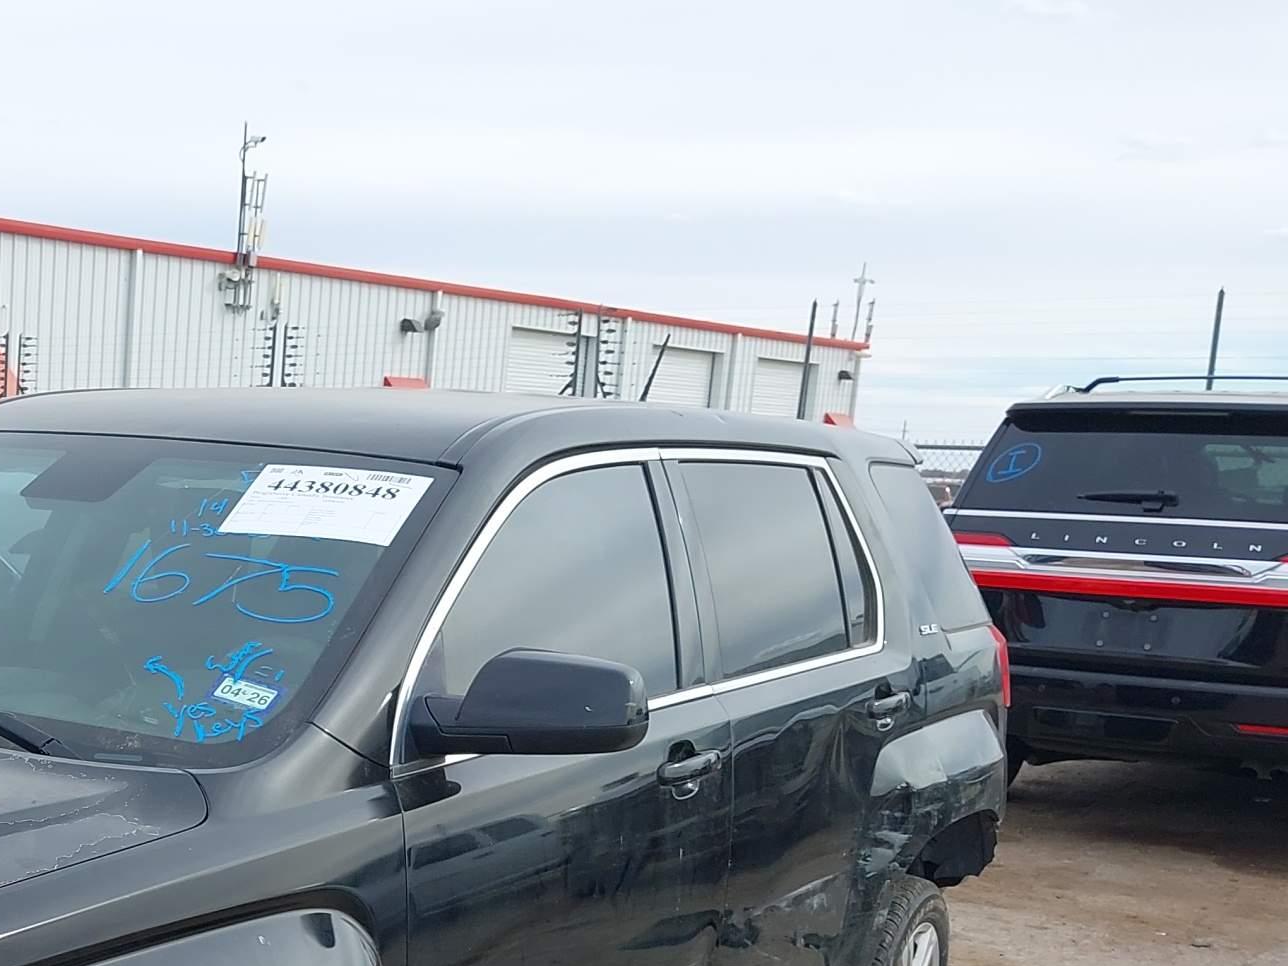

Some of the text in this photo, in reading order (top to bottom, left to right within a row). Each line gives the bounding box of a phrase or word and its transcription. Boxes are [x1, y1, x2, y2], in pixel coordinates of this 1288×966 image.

[267, 478, 401, 501] 44380848
[1030, 530, 1264, 554] LINCOLN
[103, 538, 341, 624] 1675
[919, 623, 940, 636] SLE
[220, 684, 244, 699] 04
[247, 691, 271, 707] 26
